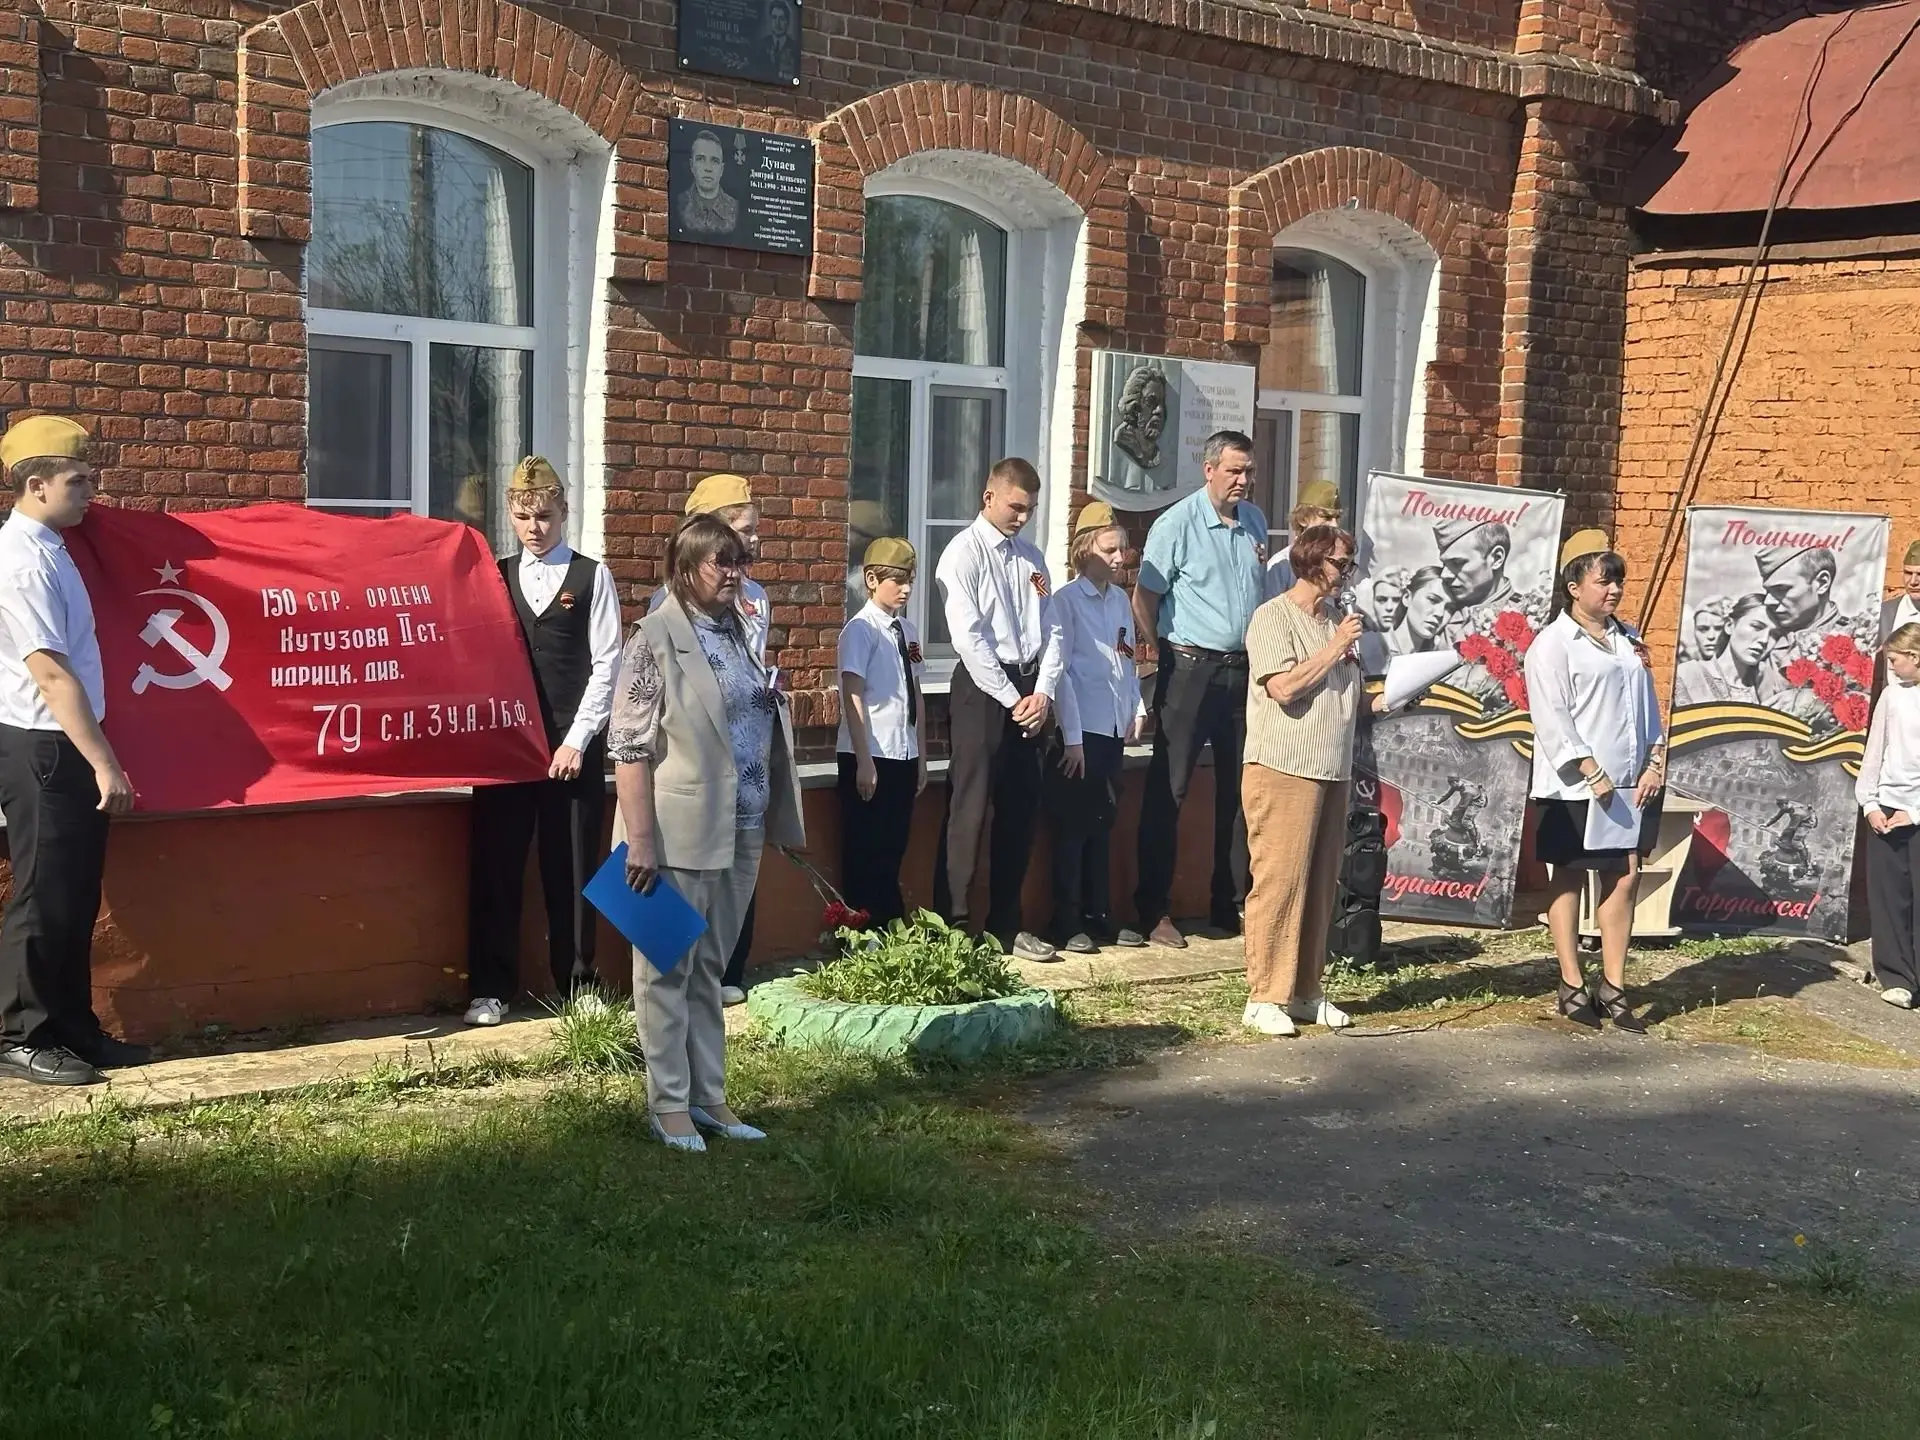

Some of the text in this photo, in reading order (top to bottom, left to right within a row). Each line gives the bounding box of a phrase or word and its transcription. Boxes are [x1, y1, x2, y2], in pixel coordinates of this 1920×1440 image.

[750, 169, 774, 182] Дмитрий
[761, 156, 796, 171] Дунаев
[1401, 490, 1530, 528] Помним!
[1721, 520, 1856, 552] Помним!
[261, 584, 432, 618] 150 СТР. ОРДЕНА
[271, 659, 405, 688] ИДРИЦК. ДИВ.
[312, 703, 362, 756] 79
[1679, 885, 1822, 921] Гордимся!
